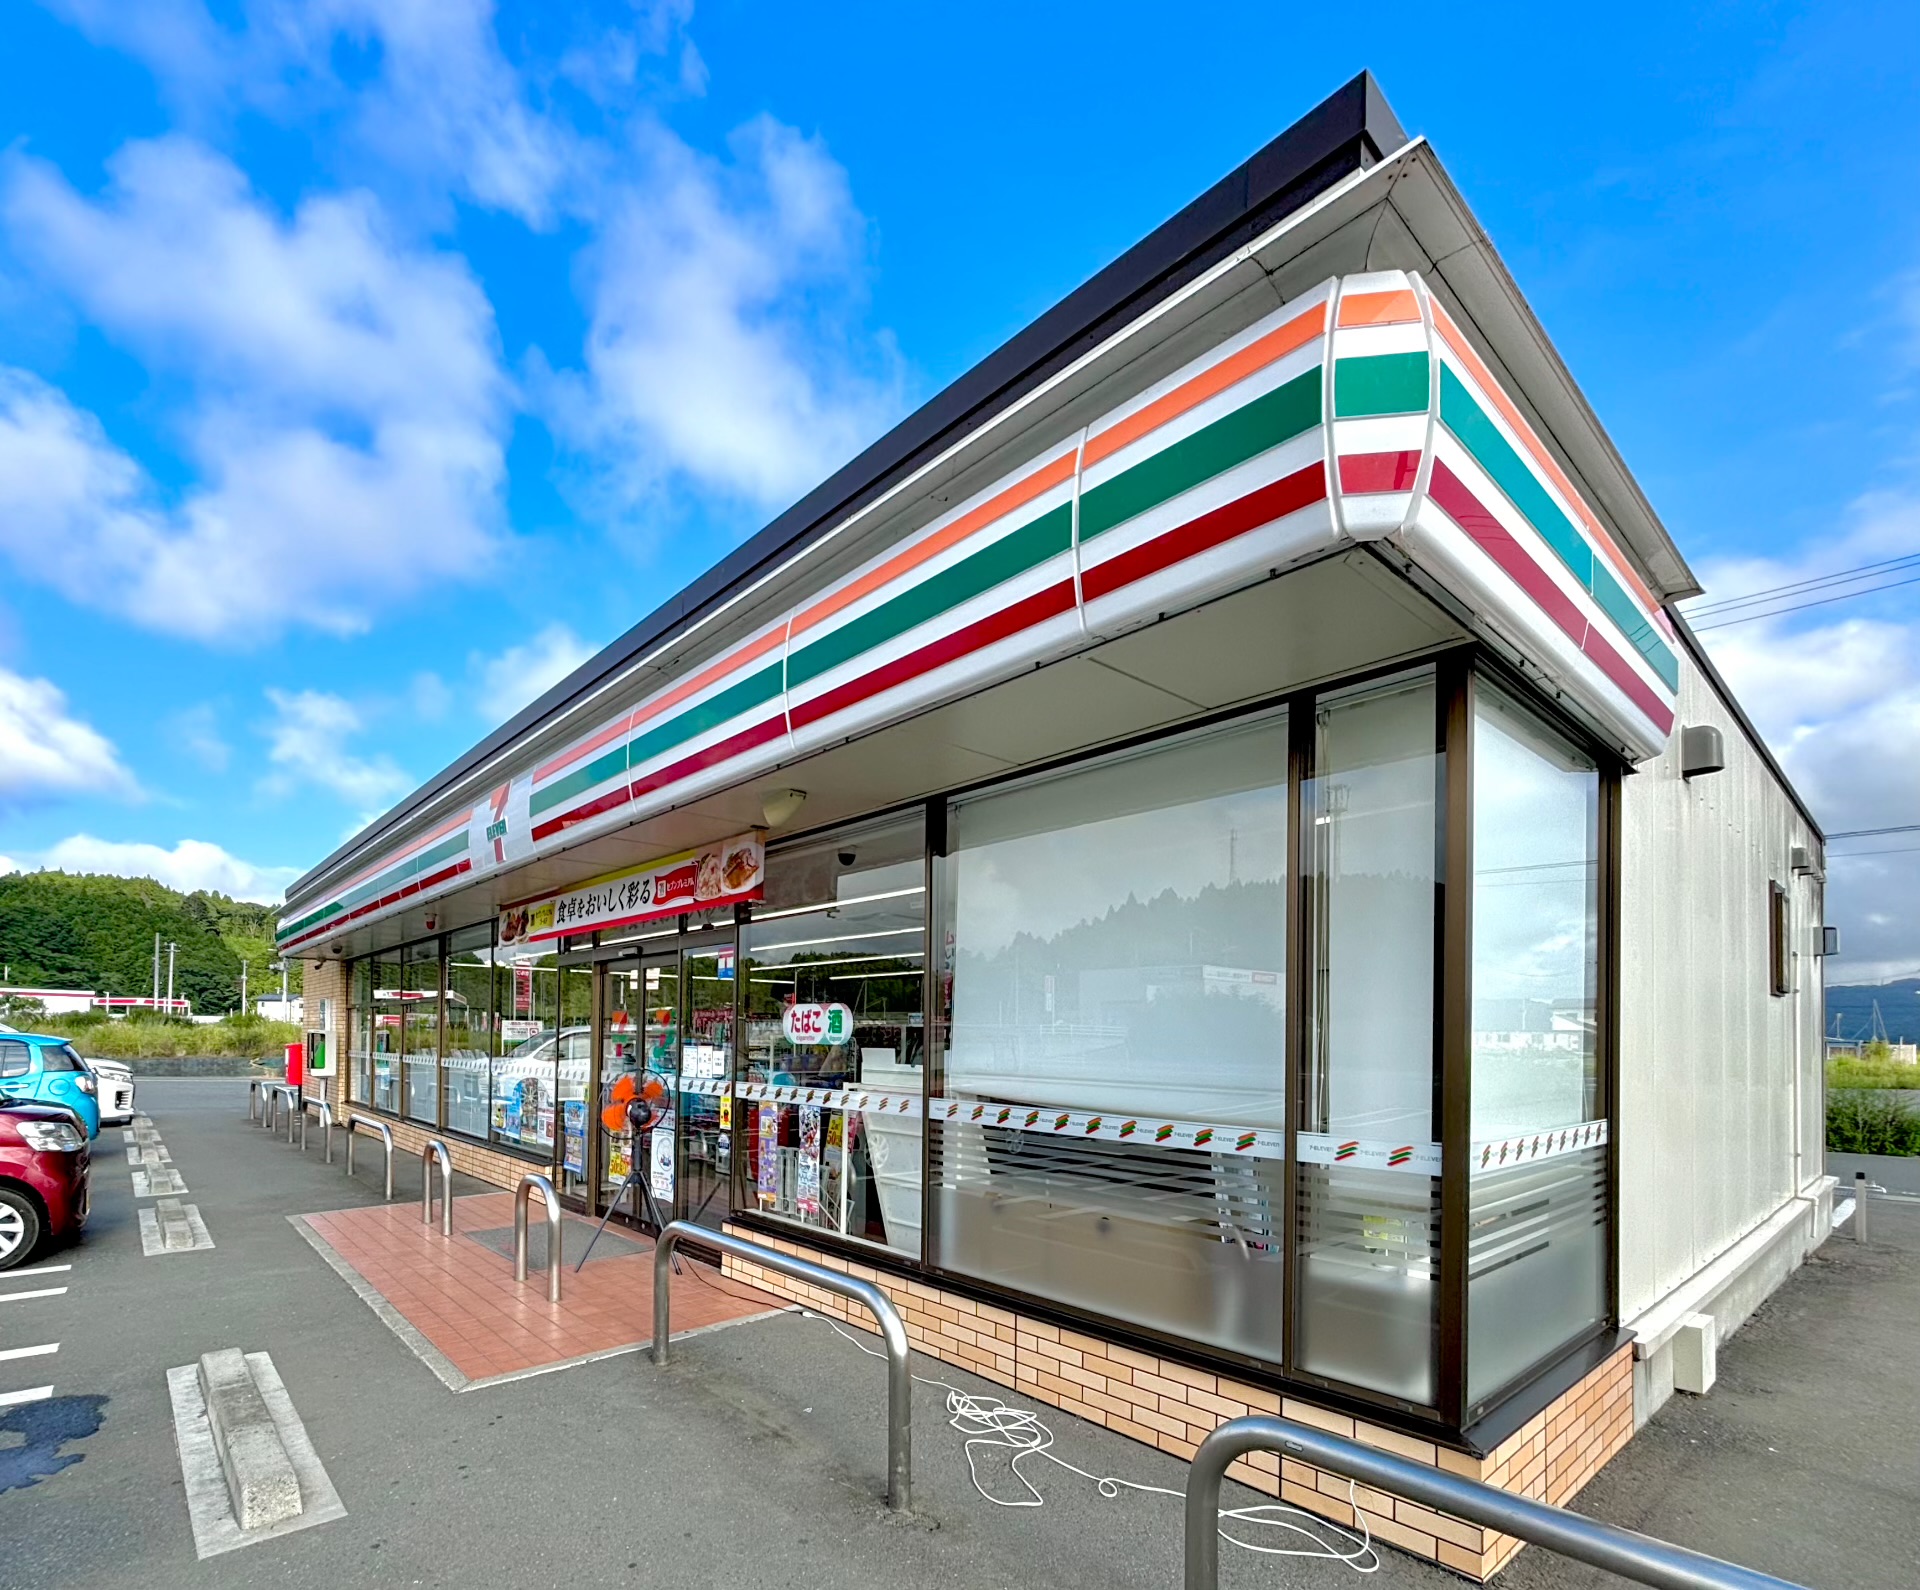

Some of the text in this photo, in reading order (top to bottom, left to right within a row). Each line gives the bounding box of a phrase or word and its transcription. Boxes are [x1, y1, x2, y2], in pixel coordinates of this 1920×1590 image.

[556, 878, 651, 924] 食卓をおいしく彩る
[790, 1008, 822, 1033] たばこ
[827, 1009, 843, 1033] 酒
